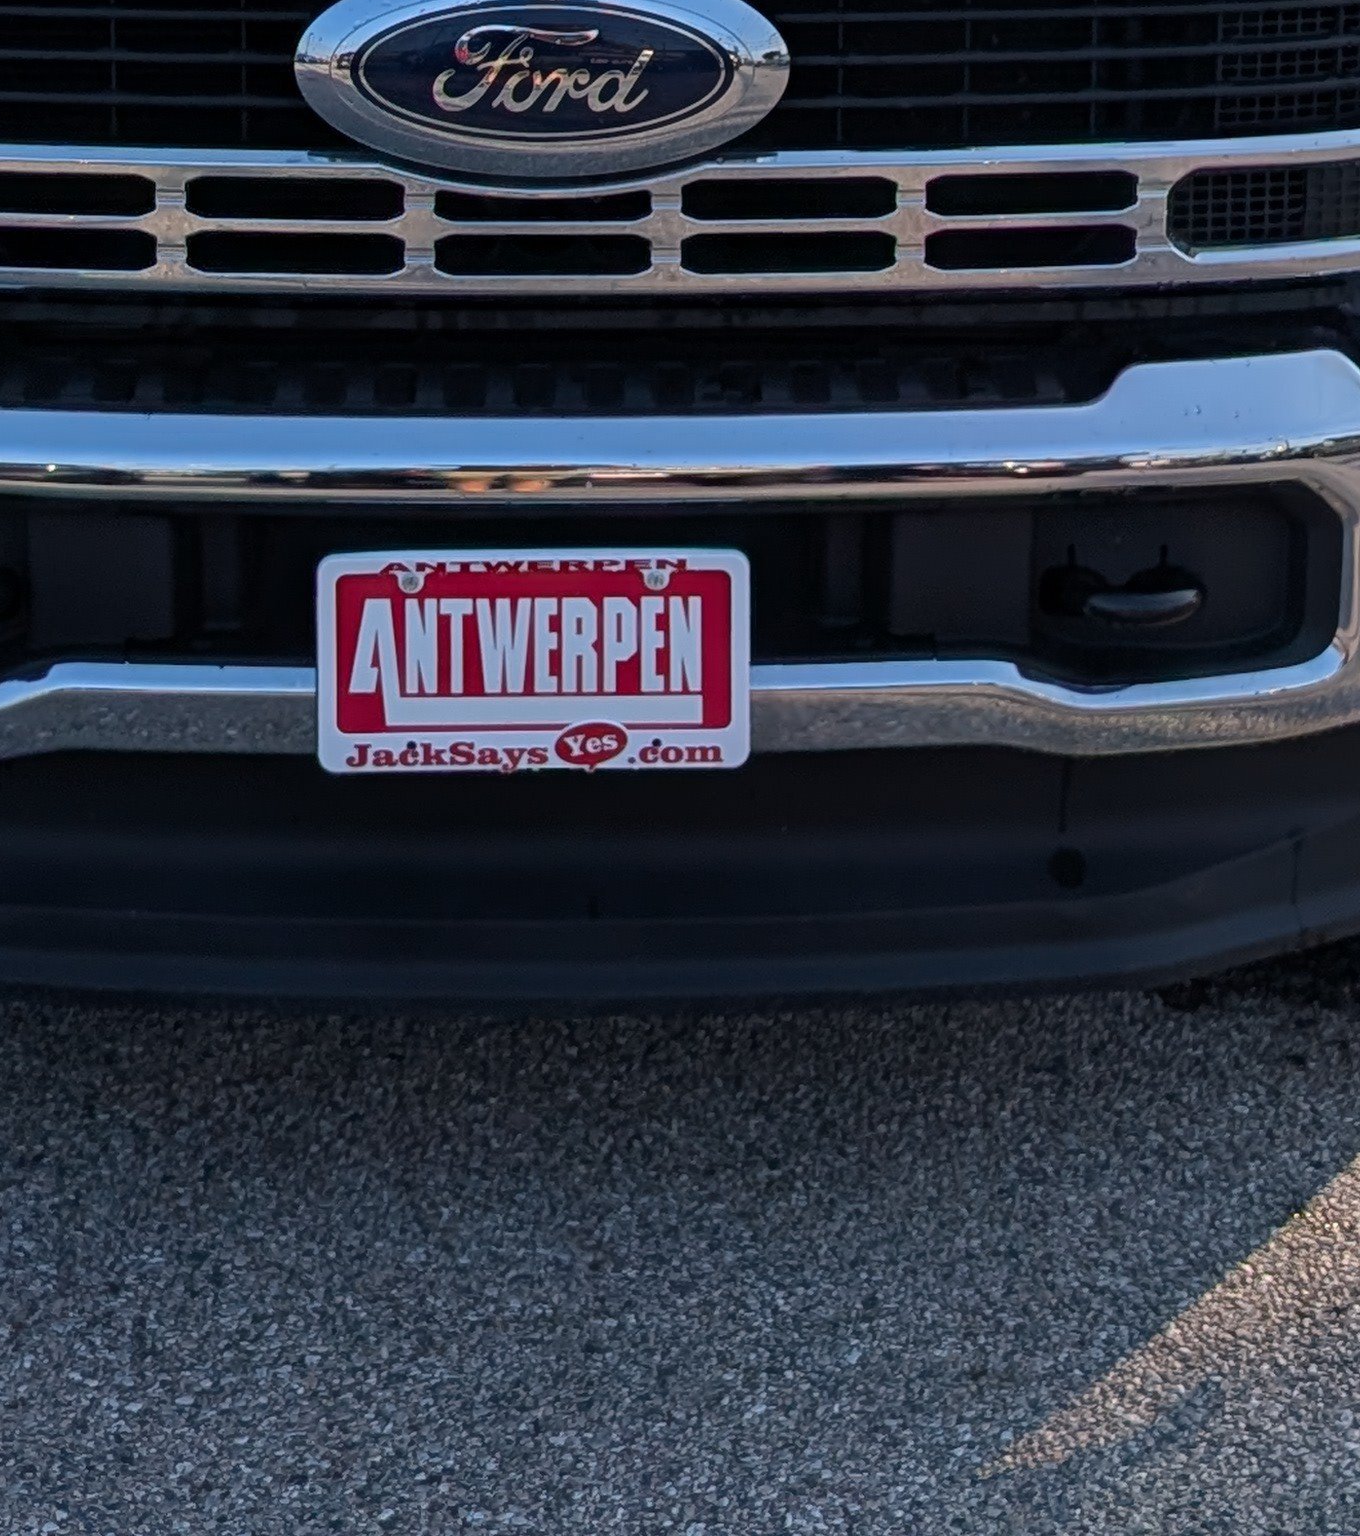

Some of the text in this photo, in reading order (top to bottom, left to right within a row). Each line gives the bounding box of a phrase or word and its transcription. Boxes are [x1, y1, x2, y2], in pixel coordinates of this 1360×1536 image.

[433, 23, 655, 113] Ford
[348, 595, 703, 695] ANTWERPEN
[345, 733, 724, 772] JackSays Yes .com
